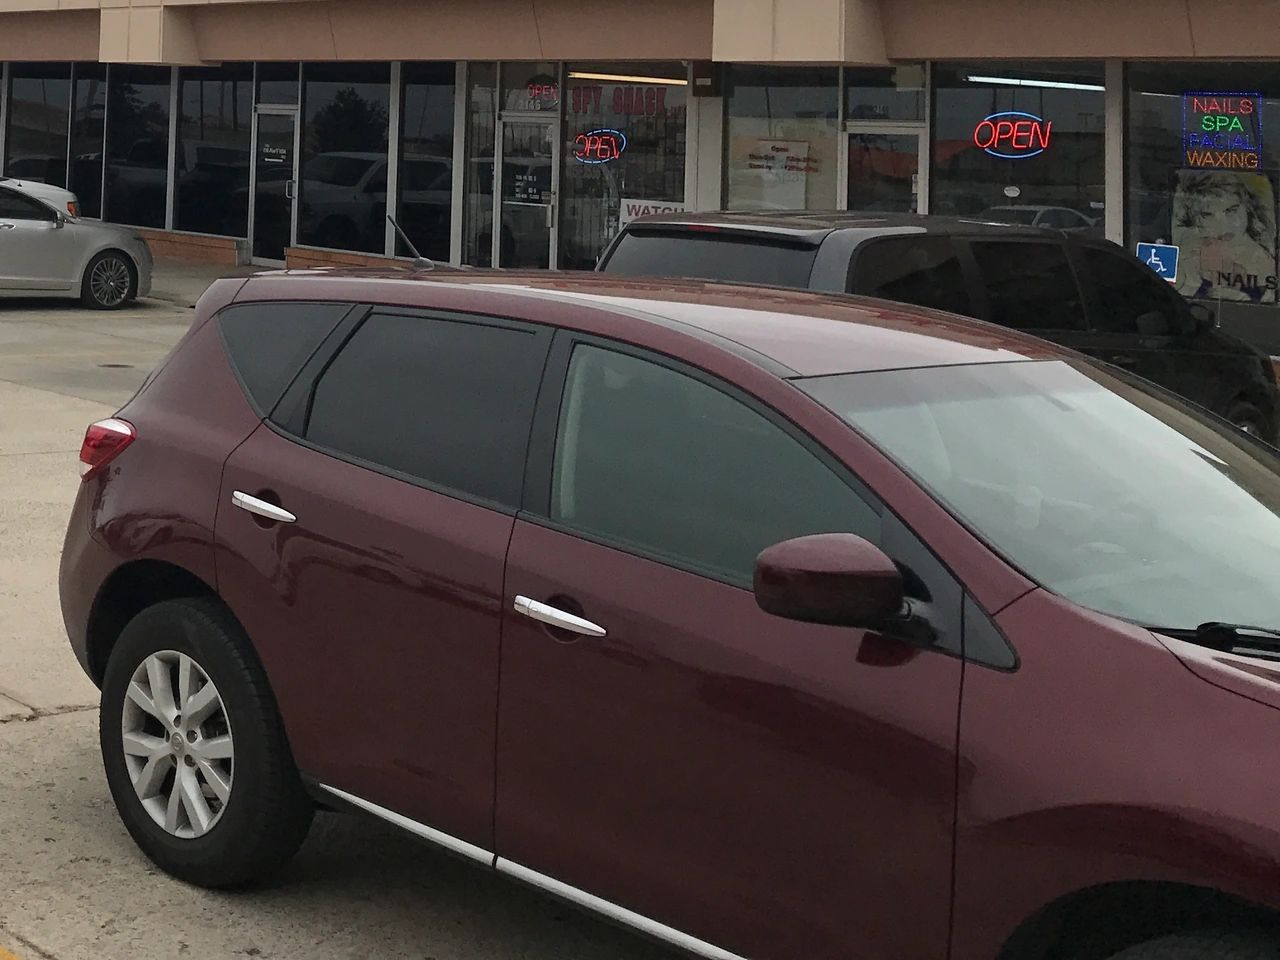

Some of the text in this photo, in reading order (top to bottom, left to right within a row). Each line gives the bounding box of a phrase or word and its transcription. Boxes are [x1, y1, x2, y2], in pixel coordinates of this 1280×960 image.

[527, 83, 558, 100] OPEN
[1192, 97, 1253, 114] NAILS
[1201, 115, 1244, 132] SPA
[974, 120, 1052, 148] OPEN
[1189, 132, 1257, 150] FACIAL
[575, 134, 620, 160] OPEN
[1186, 150, 1258, 168] WAXING
[1217, 270, 1279, 290] NAILS
